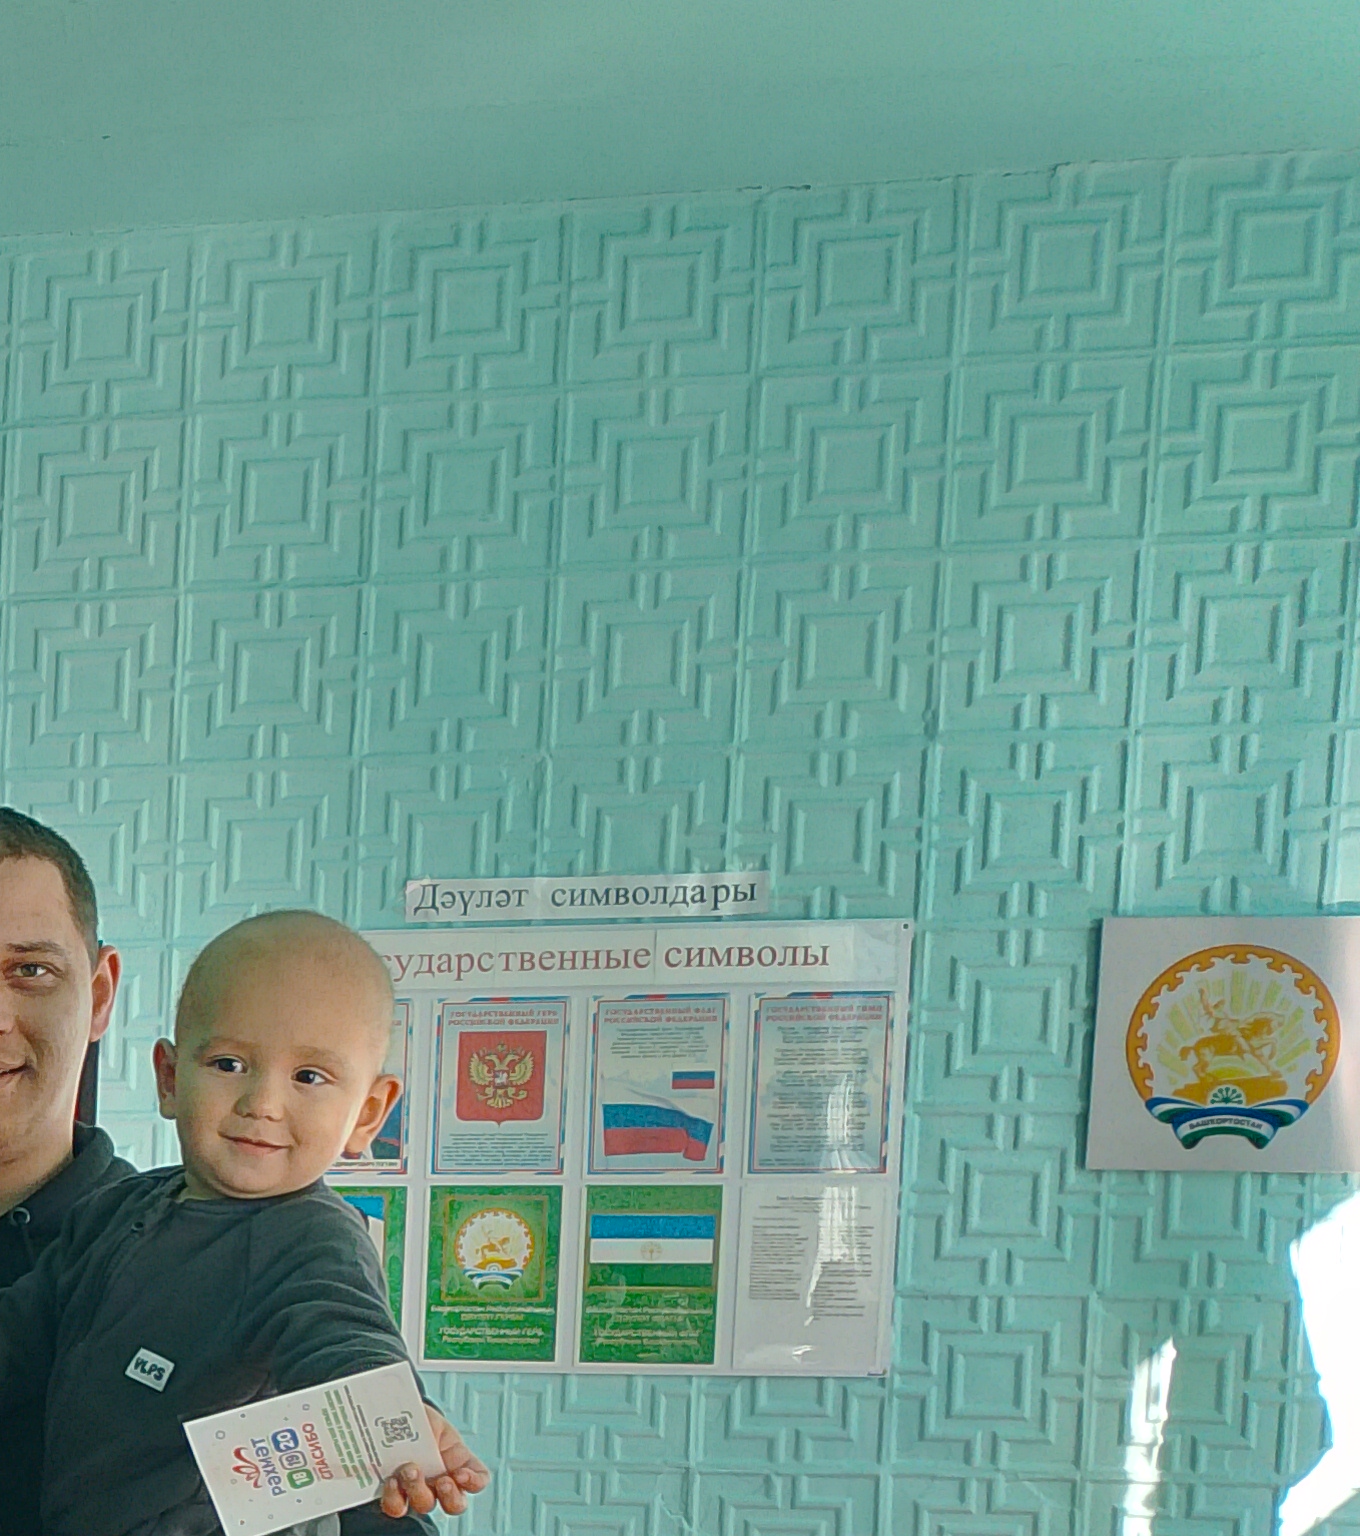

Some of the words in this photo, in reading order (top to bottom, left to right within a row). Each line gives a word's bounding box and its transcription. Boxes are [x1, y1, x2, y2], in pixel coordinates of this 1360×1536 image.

[550, 883, 757, 911] символдары
[664, 944, 831, 968] символы
[276, 1431, 296, 1451] 20
[302, 1422, 334, 1480] СПАСИБО
[284, 1454, 302, 1467] 19
[292, 1471, 311, 1486] 18
